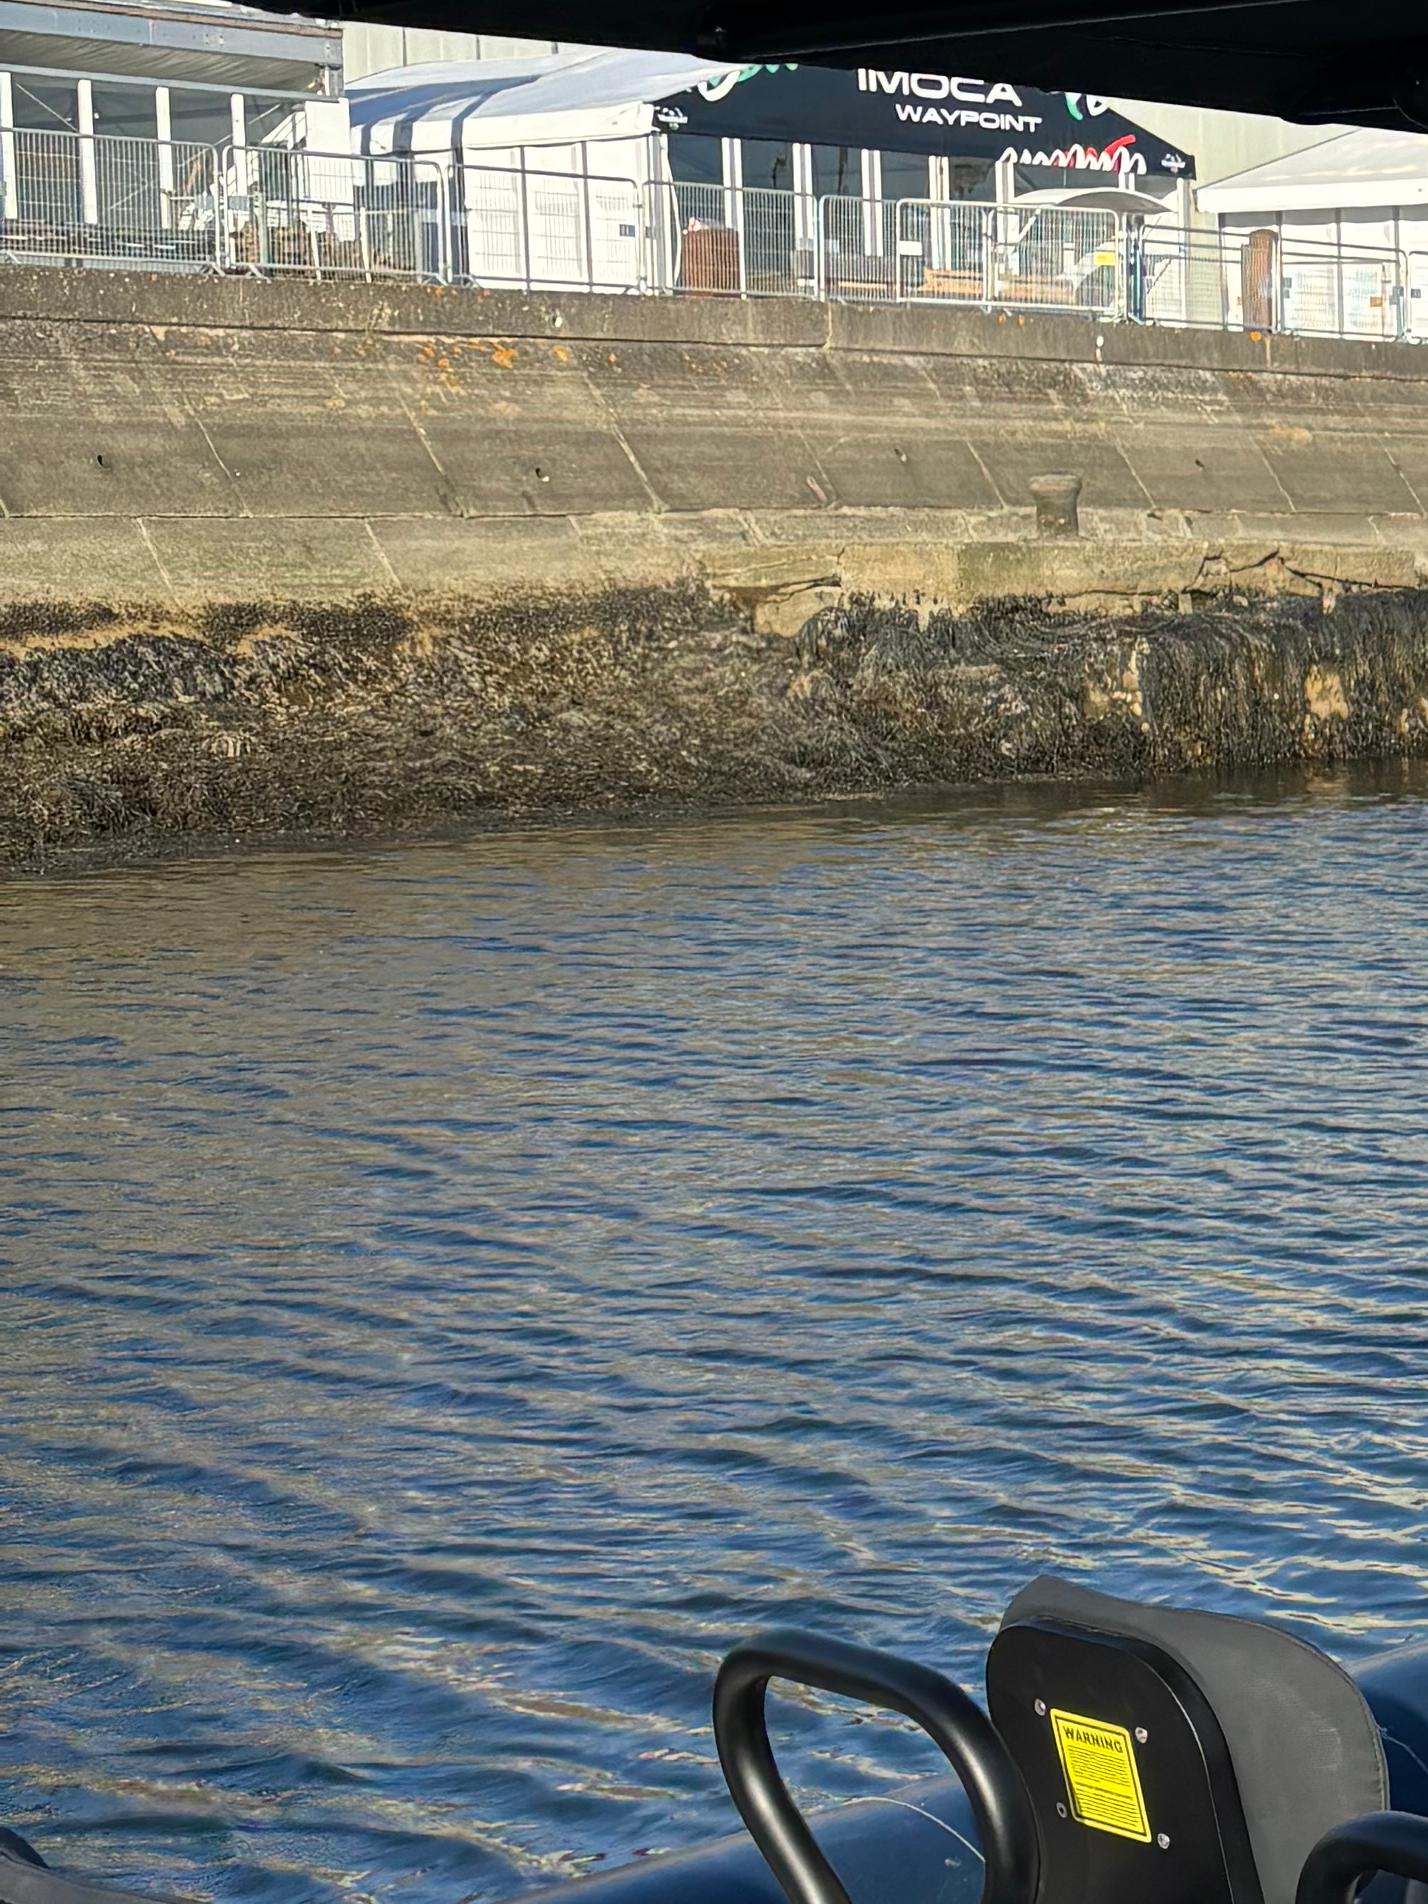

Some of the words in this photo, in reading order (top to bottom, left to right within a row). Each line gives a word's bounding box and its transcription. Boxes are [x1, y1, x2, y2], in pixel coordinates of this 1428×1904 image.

[857, 68, 1023, 107] IMOCA
[895, 104, 1043, 133] WAYPOINT
[1063, 1726, 1123, 1754] WARNING
